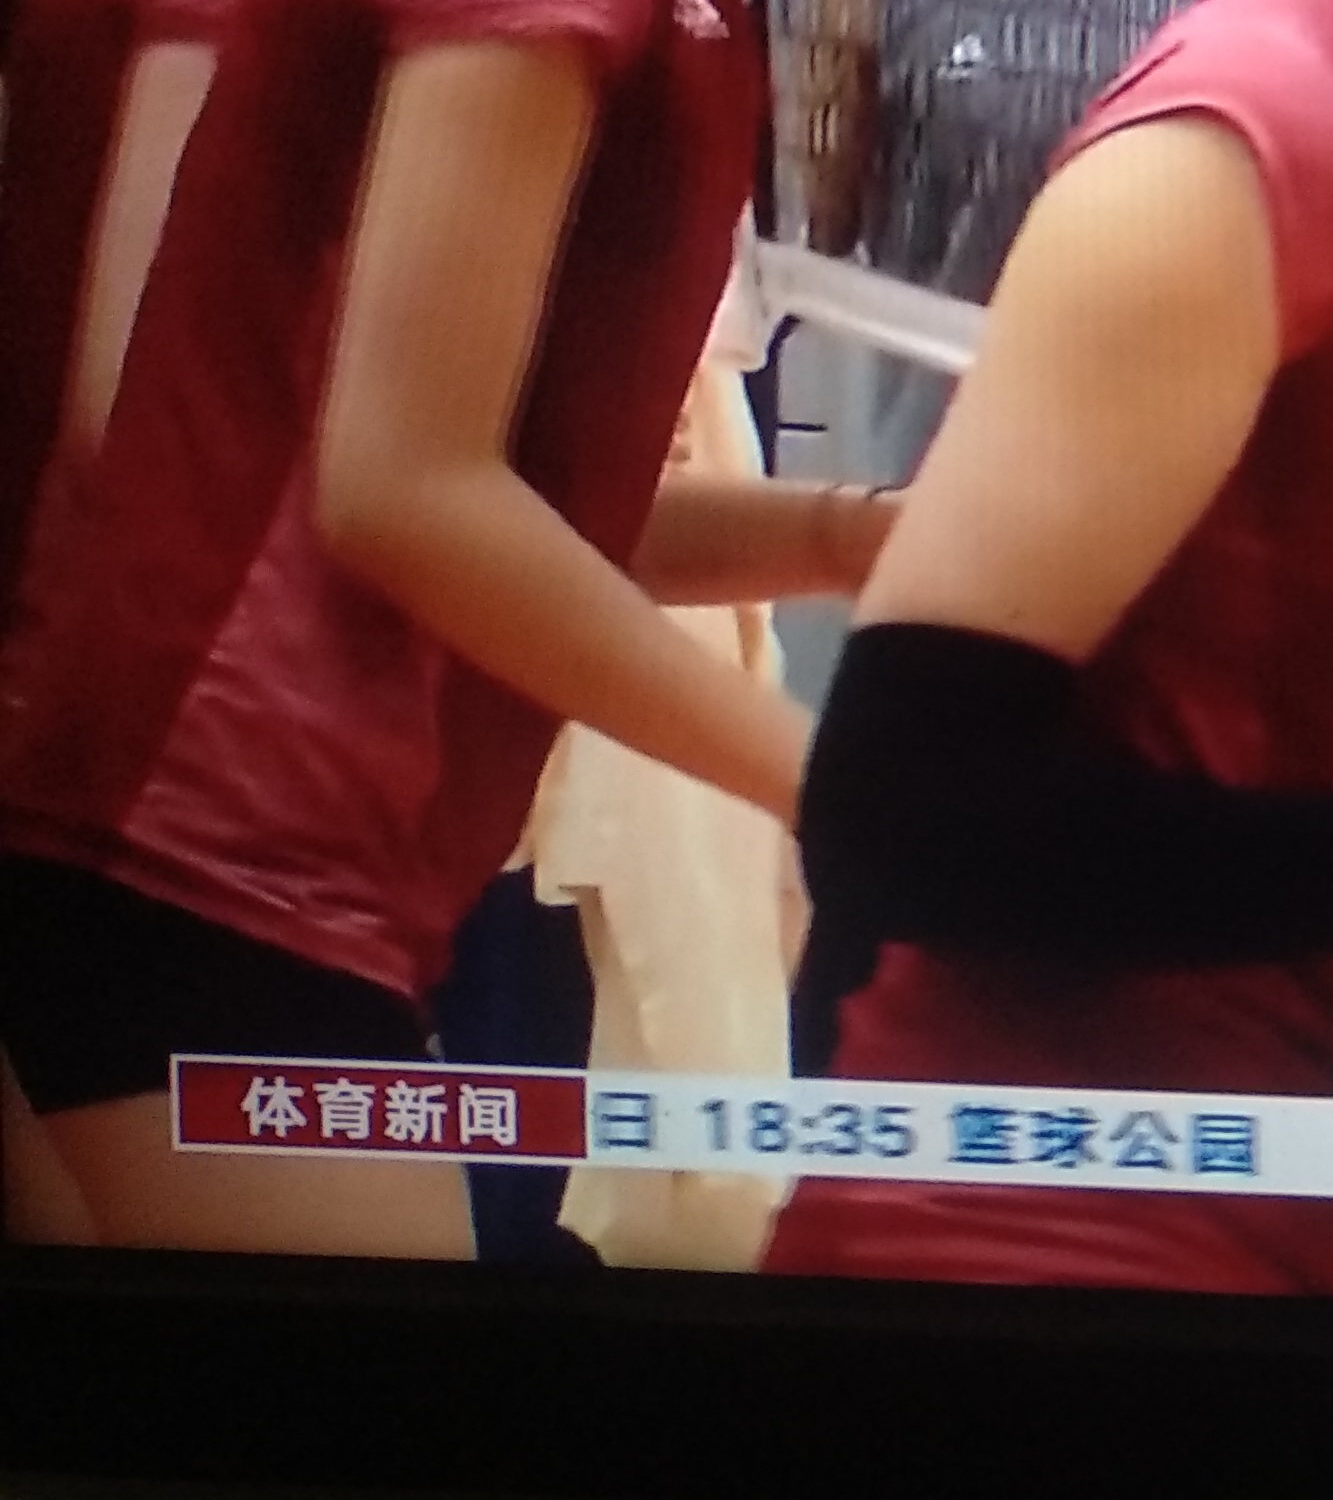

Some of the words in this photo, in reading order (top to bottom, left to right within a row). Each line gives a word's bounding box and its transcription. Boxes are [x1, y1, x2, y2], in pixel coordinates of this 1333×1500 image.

[240, 1075, 519, 1148] 体育新闻
[699, 1098, 918, 1160] 18:35
[946, 1101, 1260, 1178] 篮球公园
